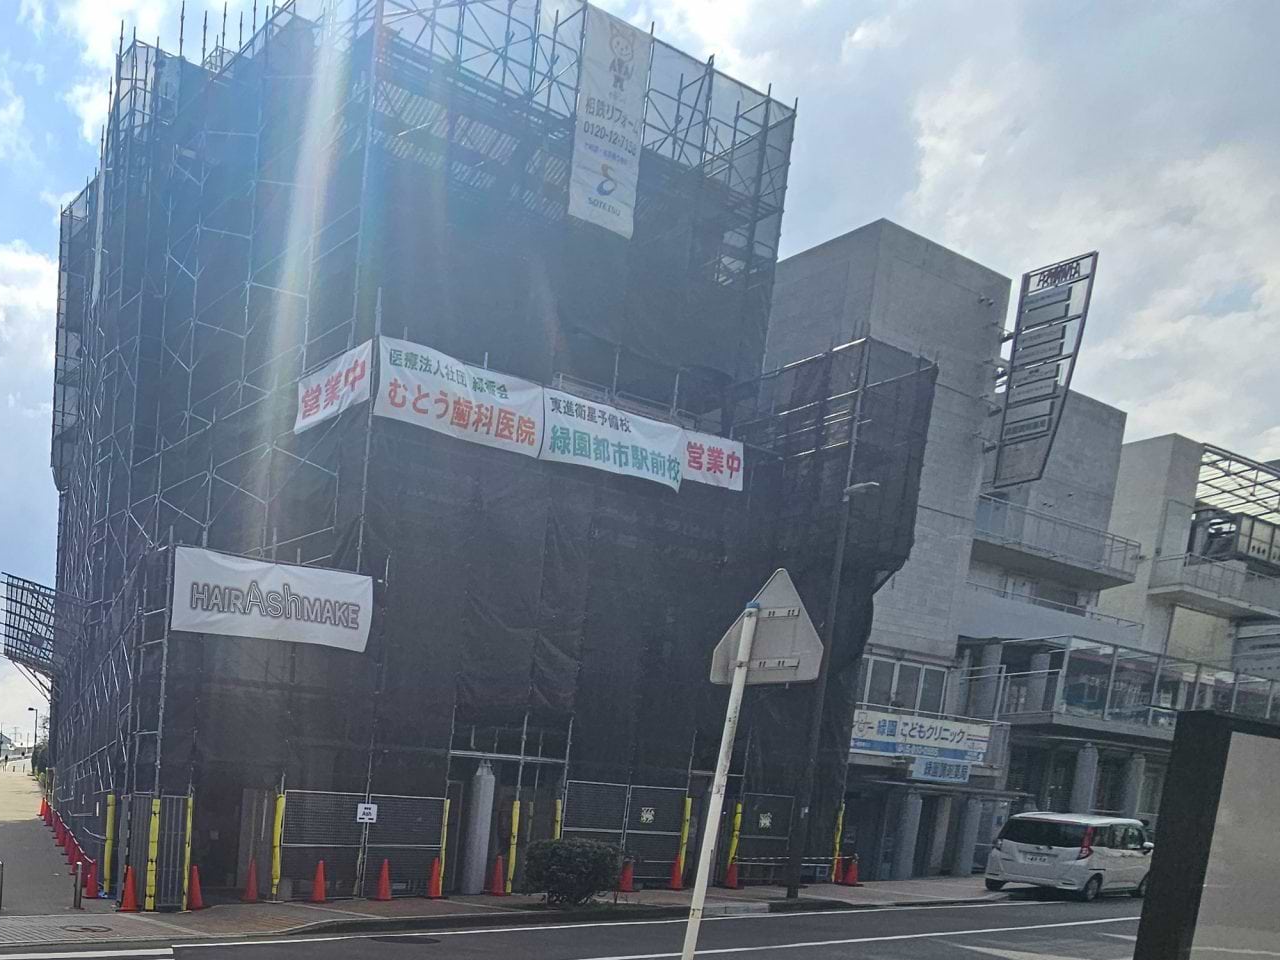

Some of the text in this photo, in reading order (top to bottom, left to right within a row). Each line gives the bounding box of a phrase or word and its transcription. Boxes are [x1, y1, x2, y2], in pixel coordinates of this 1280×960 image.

[389, 348, 468, 388] 医療法人社団
[301, 358, 366, 420] 営業中
[388, 377, 537, 447] むとう歯科医院
[549, 396, 632, 434] 東進衛星予備校
[548, 424, 681, 484] 緑園都市駅前校
[686, 441, 742, 480] 営業中
[900, 721, 966, 744] こどもクリニック
